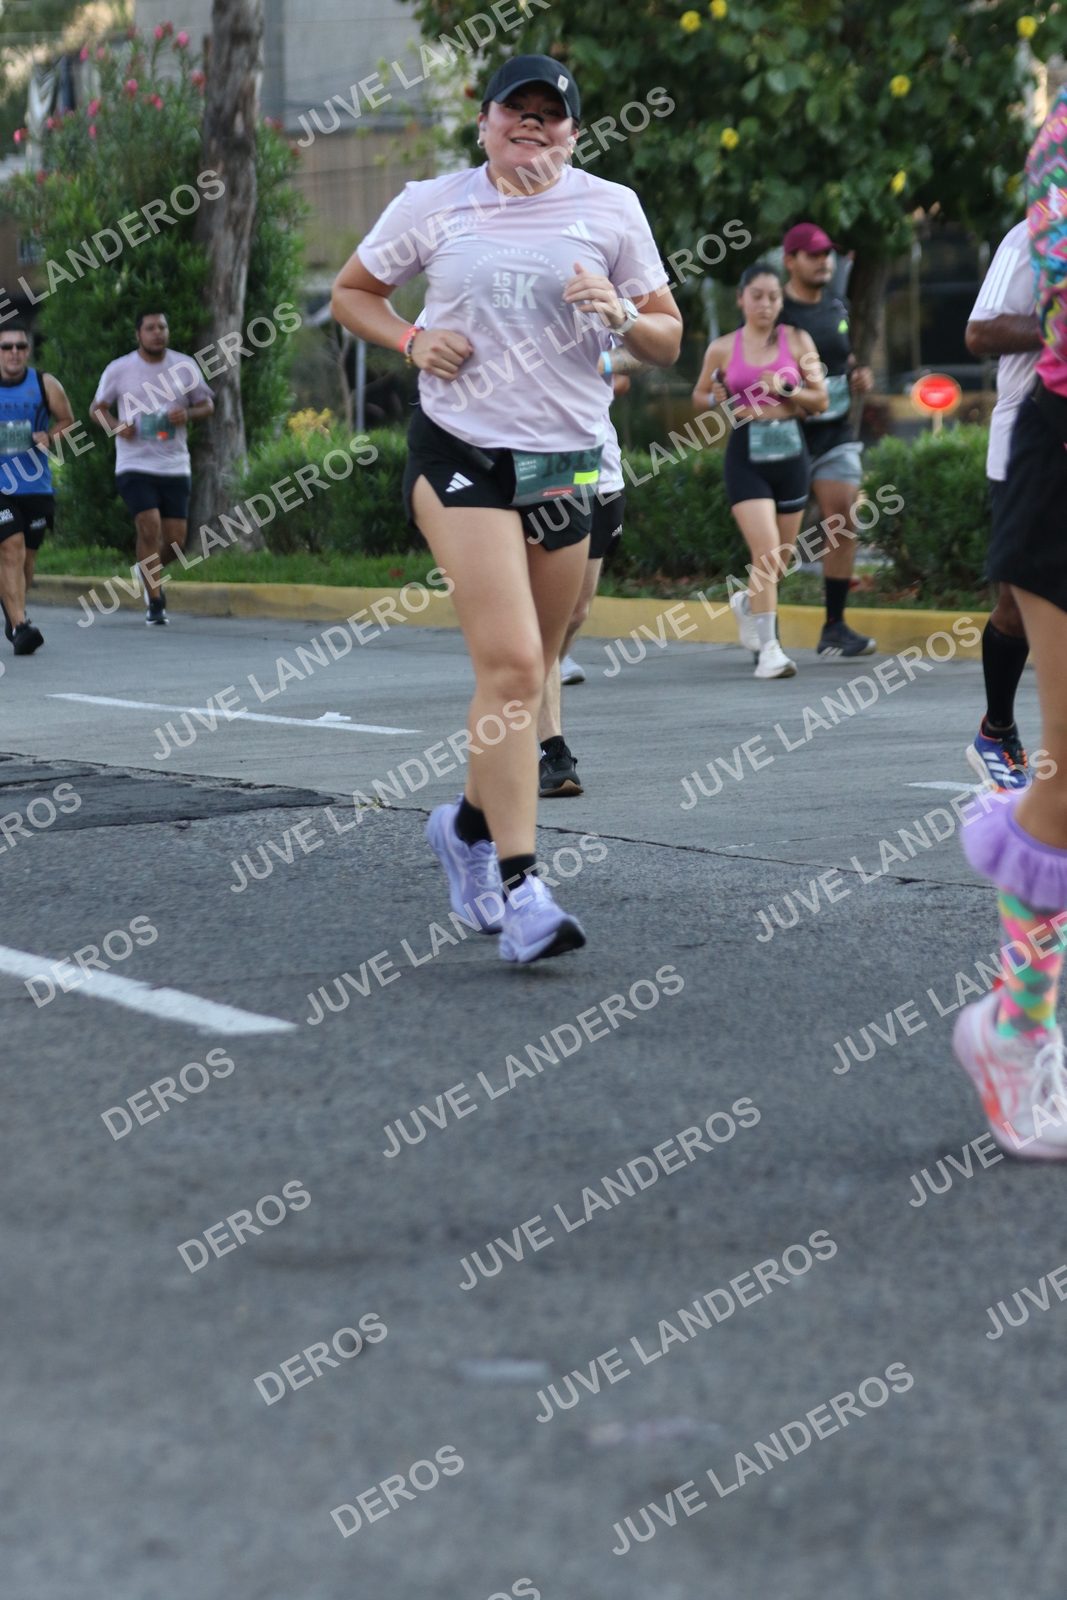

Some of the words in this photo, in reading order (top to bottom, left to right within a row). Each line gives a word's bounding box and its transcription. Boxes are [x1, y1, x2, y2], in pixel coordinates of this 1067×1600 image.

[492, 271, 511, 287] 15
[514, 273, 539, 310] K
[492, 293, 511, 309] 30
